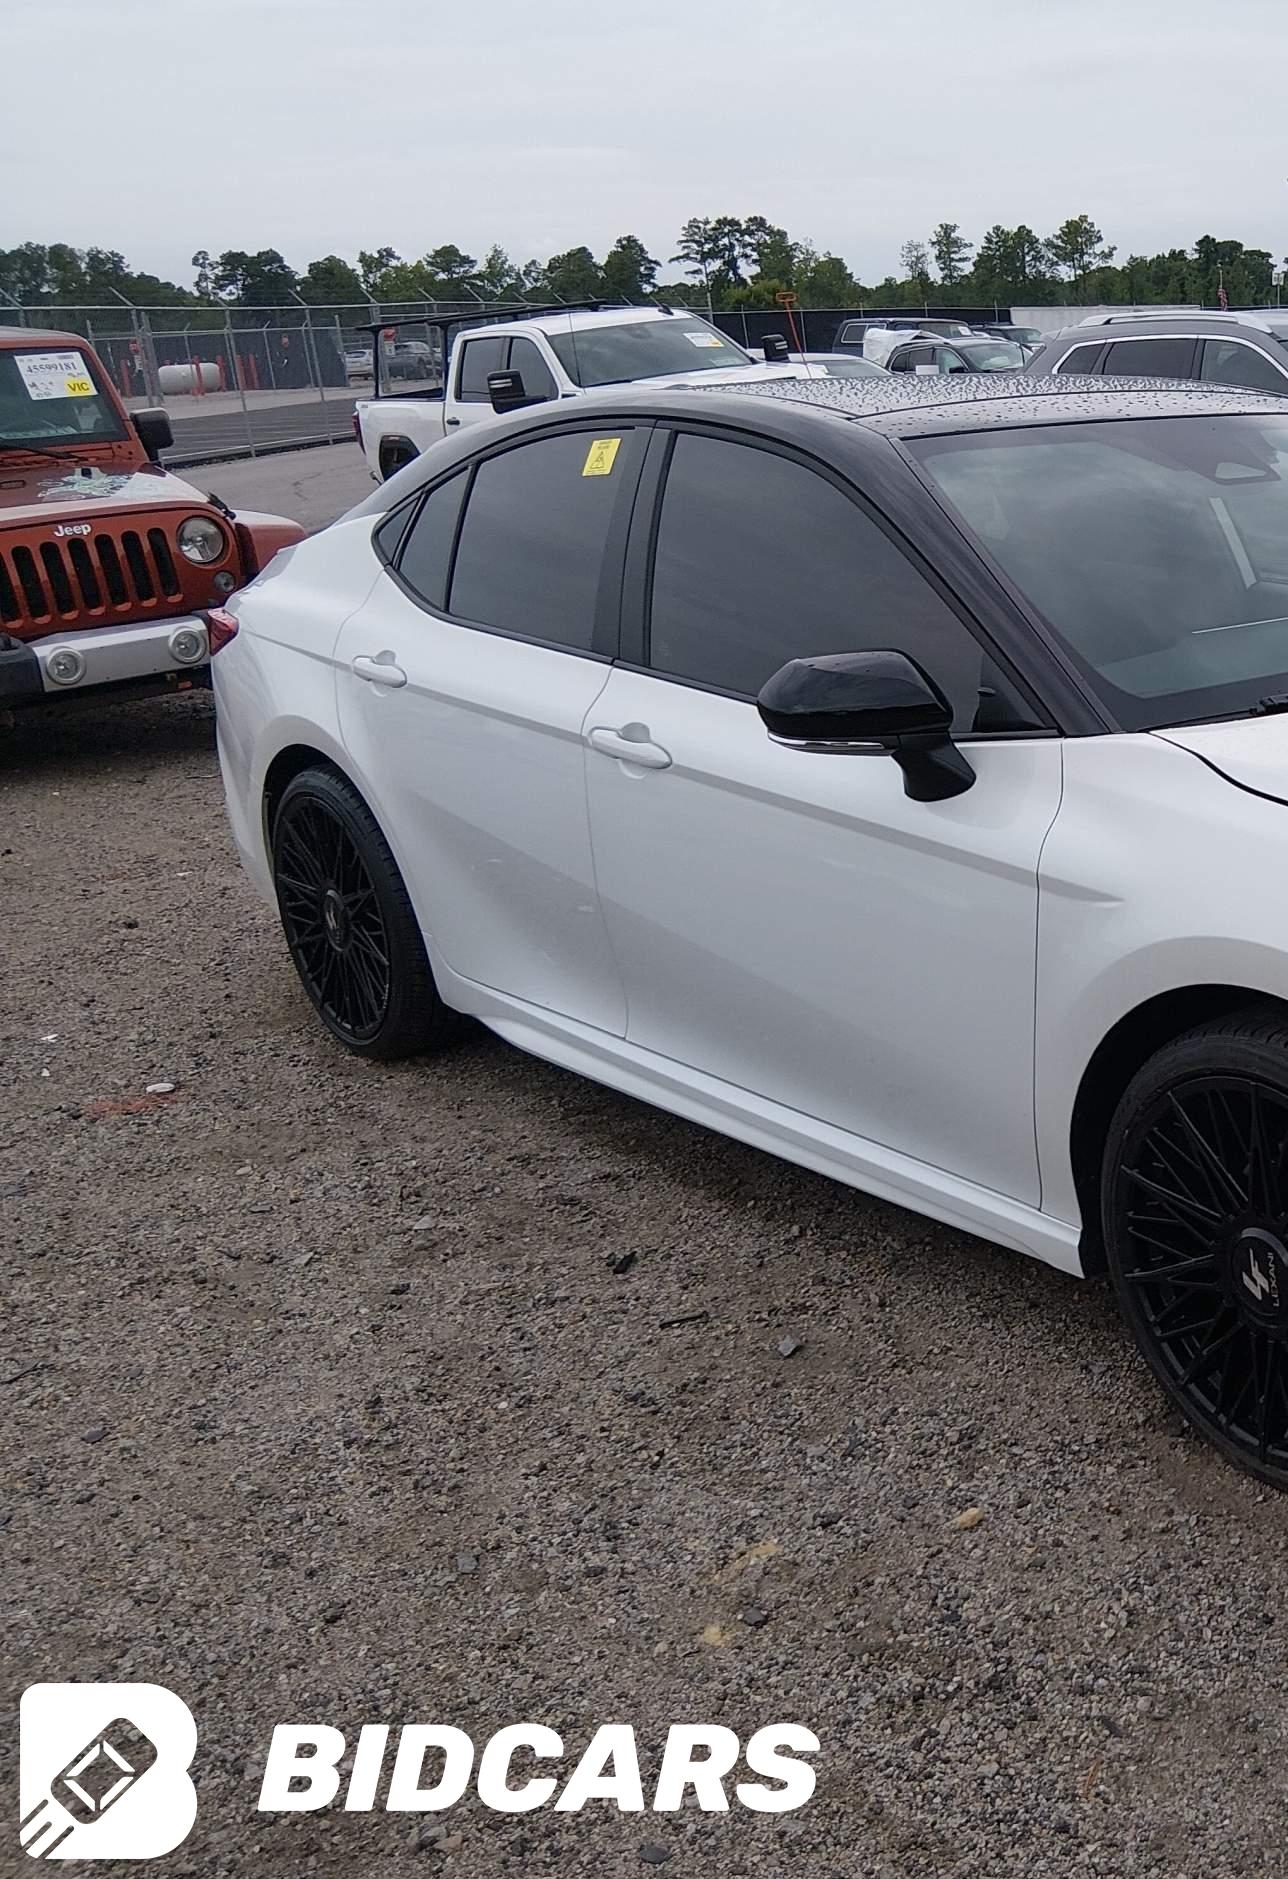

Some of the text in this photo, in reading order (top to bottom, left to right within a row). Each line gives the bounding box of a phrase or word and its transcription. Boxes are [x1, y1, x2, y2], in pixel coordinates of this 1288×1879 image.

[67, 382, 90, 392] VIC
[54, 522, 92, 537] Jeep
[1267, 1251, 1280, 1308] LEXANI
